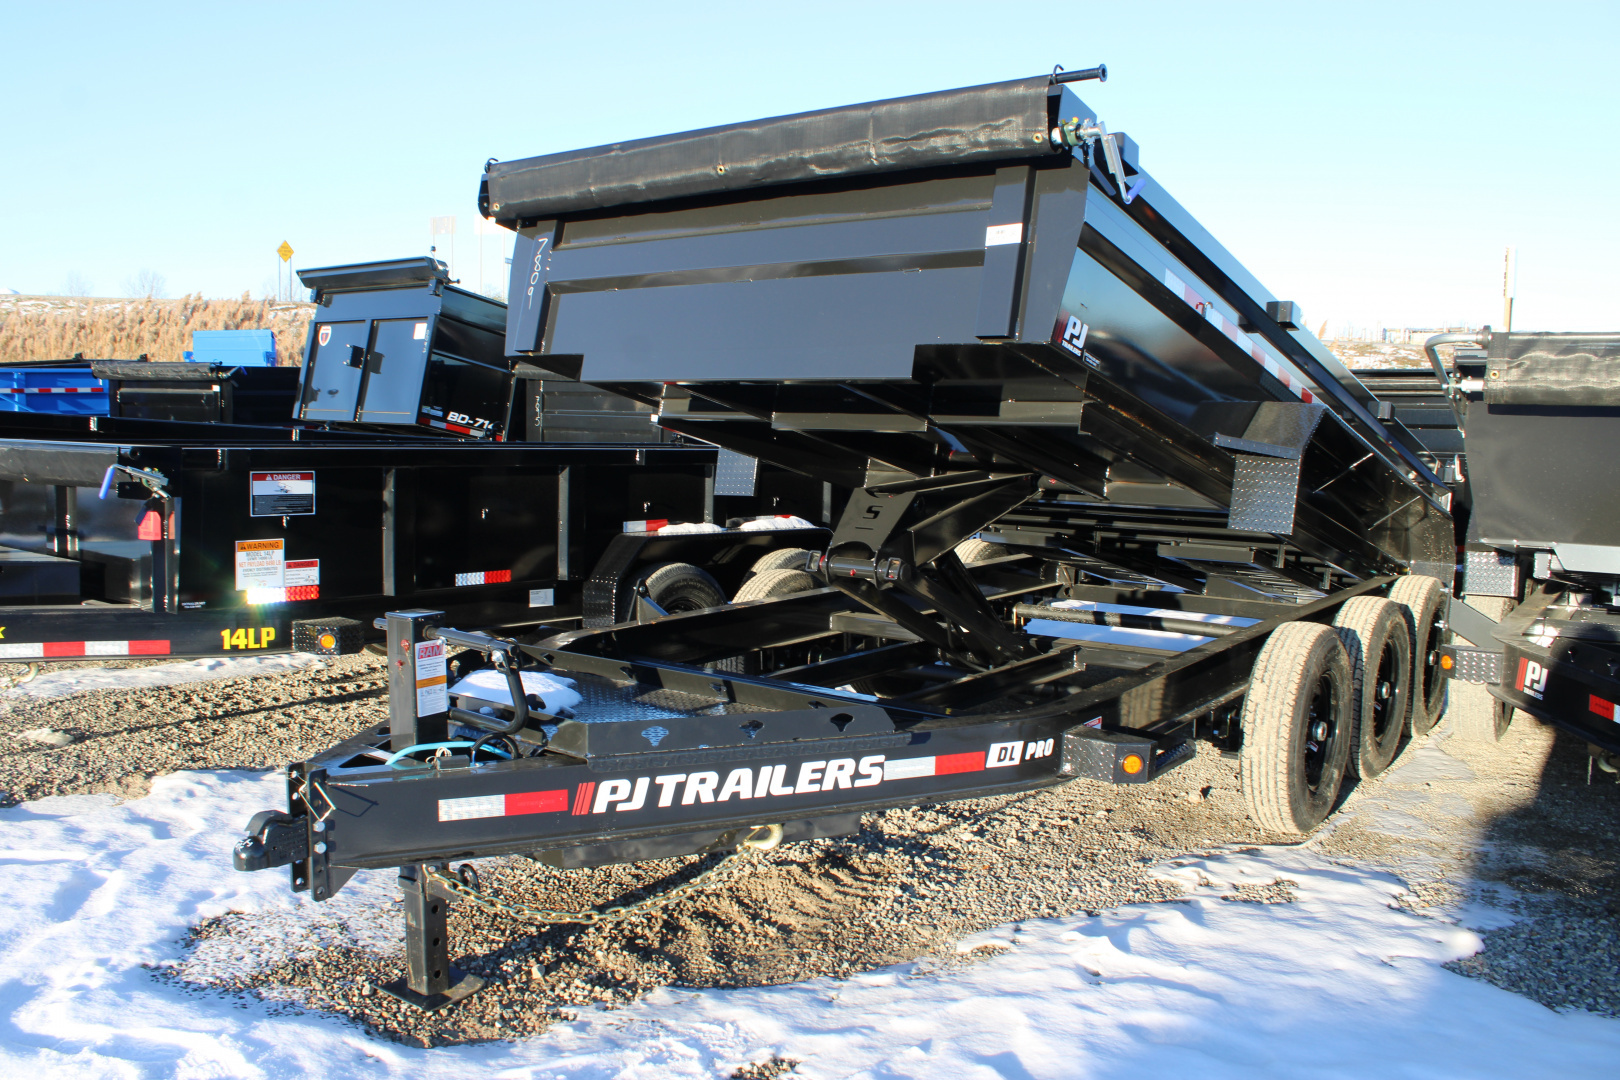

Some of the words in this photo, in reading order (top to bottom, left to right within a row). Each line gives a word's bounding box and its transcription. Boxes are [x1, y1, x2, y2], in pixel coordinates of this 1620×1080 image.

[527, 237, 549, 310] 7809
[1063, 315, 1089, 349] PJ
[273, 473, 301, 481] DANGER
[246, 541, 280, 550] WARNING
[221, 627, 275, 650] 14LP
[418, 644, 443, 659] RAM
[1524, 660, 1548, 692] PJ
[996, 745, 1016, 763] DL
[1024, 738, 1055, 761] PRO
[592, 776, 650, 814] PJ
[655, 754, 886, 808] TRAILERS
